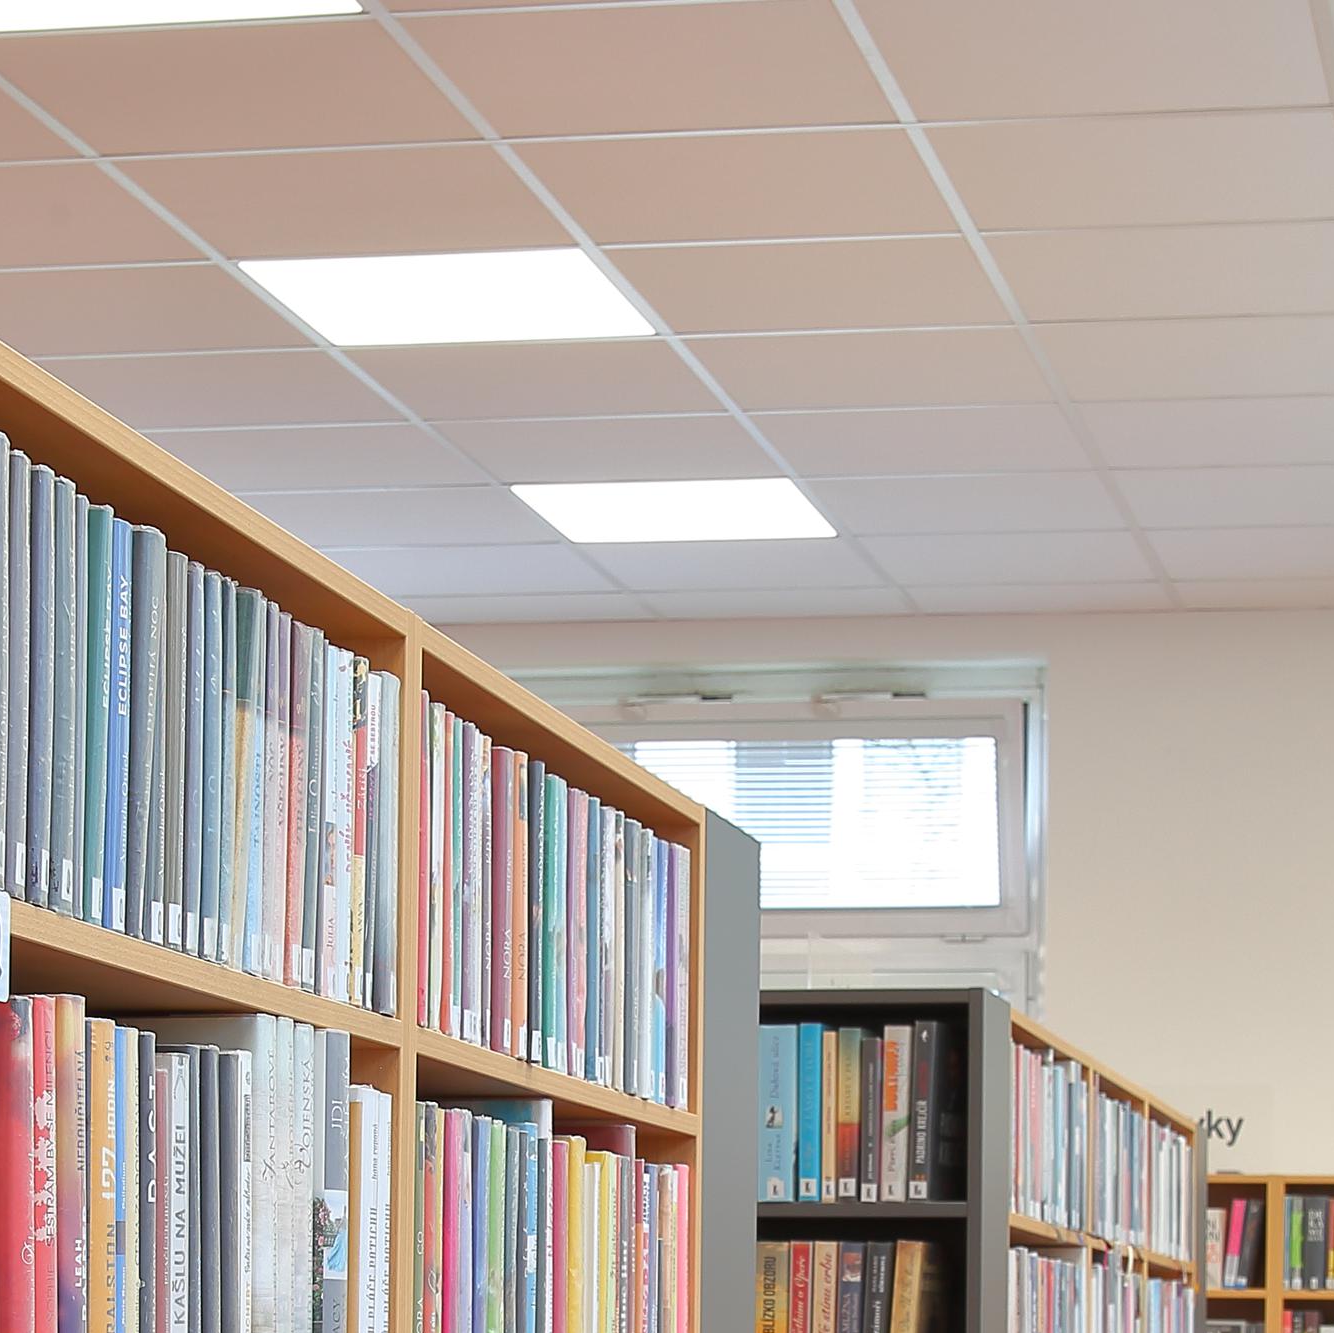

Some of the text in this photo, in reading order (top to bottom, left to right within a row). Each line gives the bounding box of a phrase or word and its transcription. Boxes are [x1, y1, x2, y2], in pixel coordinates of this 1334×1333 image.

[170, 1209, 186, 1325] KAŠLU NA
[761, 1256, 777, 1333] BLÍZKO OBZORU
